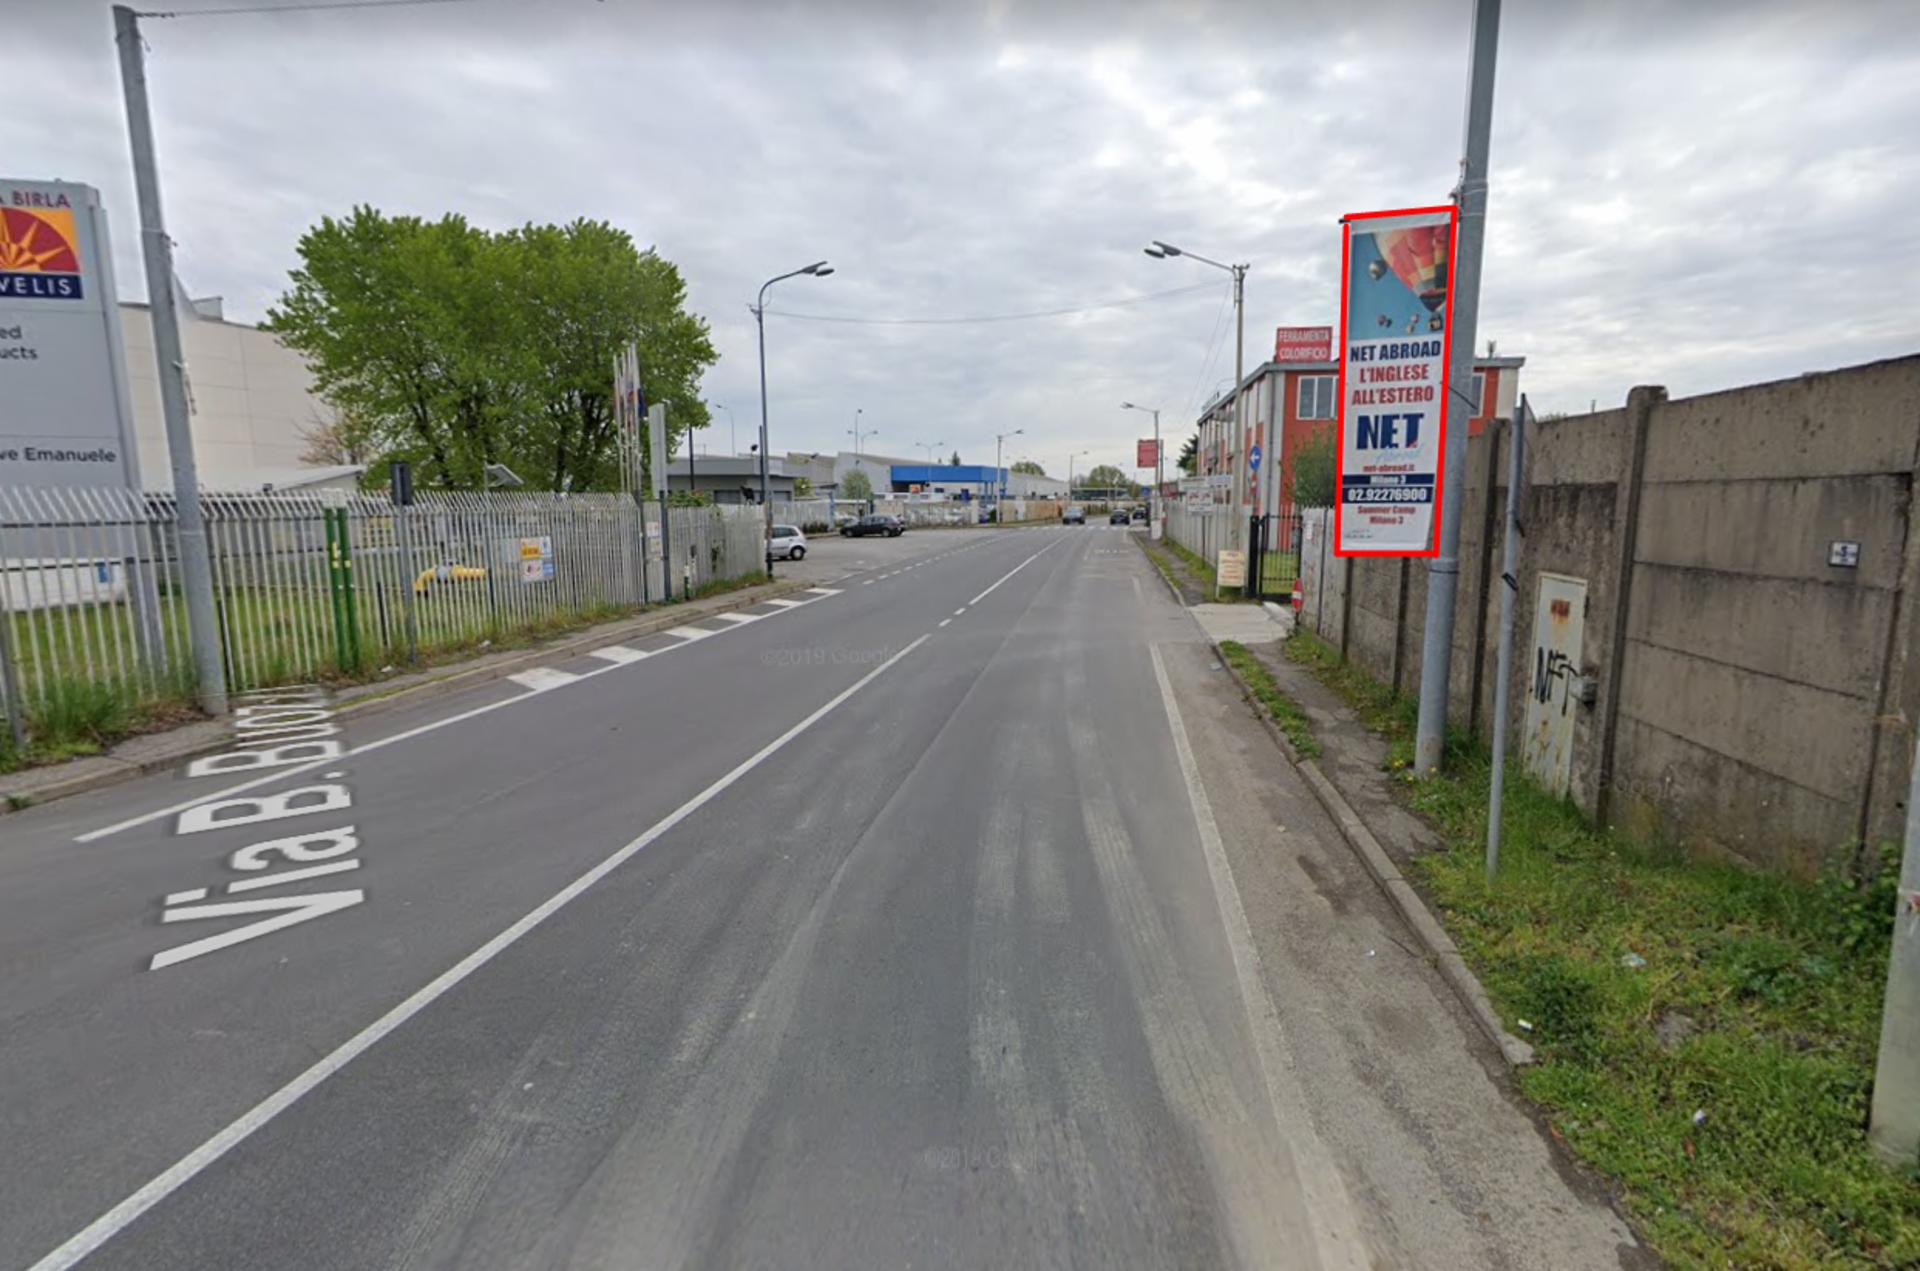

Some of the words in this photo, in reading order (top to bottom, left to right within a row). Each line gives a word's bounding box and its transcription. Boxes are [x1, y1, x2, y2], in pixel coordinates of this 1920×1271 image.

[12, 190, 71, 209] BIRLA
[1350, 345, 1376, 362] NET
[1379, 340, 1441, 360] ABROAD
[1359, 363, 1429, 383] L'INGLESE
[1352, 385, 1435, 405] ALL'ESTERO
[1355, 412, 1425, 450] NET
[25, 447, 117, 462] Emanuele
